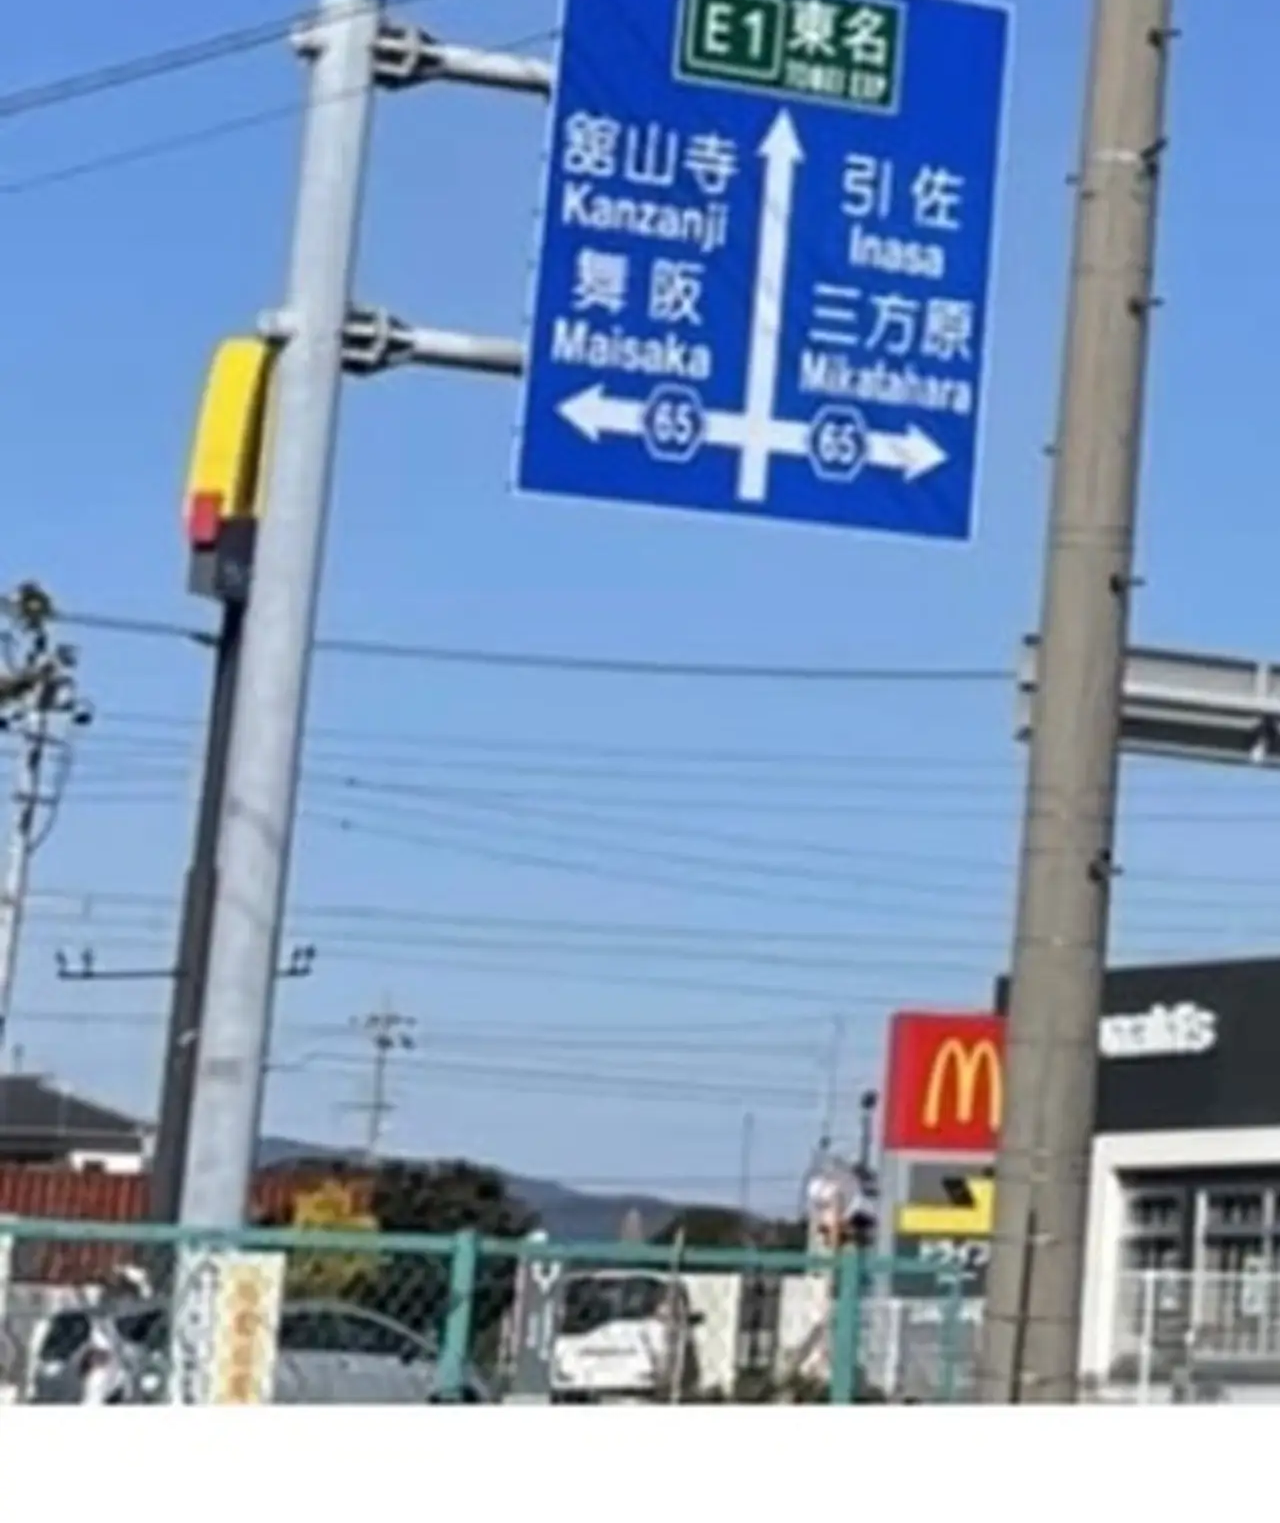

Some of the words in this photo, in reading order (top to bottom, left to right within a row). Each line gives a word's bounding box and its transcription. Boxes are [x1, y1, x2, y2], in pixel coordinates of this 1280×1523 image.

[704, 2, 766, 60] E1
[563, 180, 728, 253] Kanzanji
[839, 151, 966, 231] 引佐
[849, 222, 945, 280] Inasa
[572, 247, 706, 326] 舞阪
[551, 316, 712, 381] Maisaka
[808, 281, 974, 362] 三方原
[799, 348, 973, 416] Mikatahara
[653, 399, 694, 445] 65
[818, 421, 859, 464] 65
